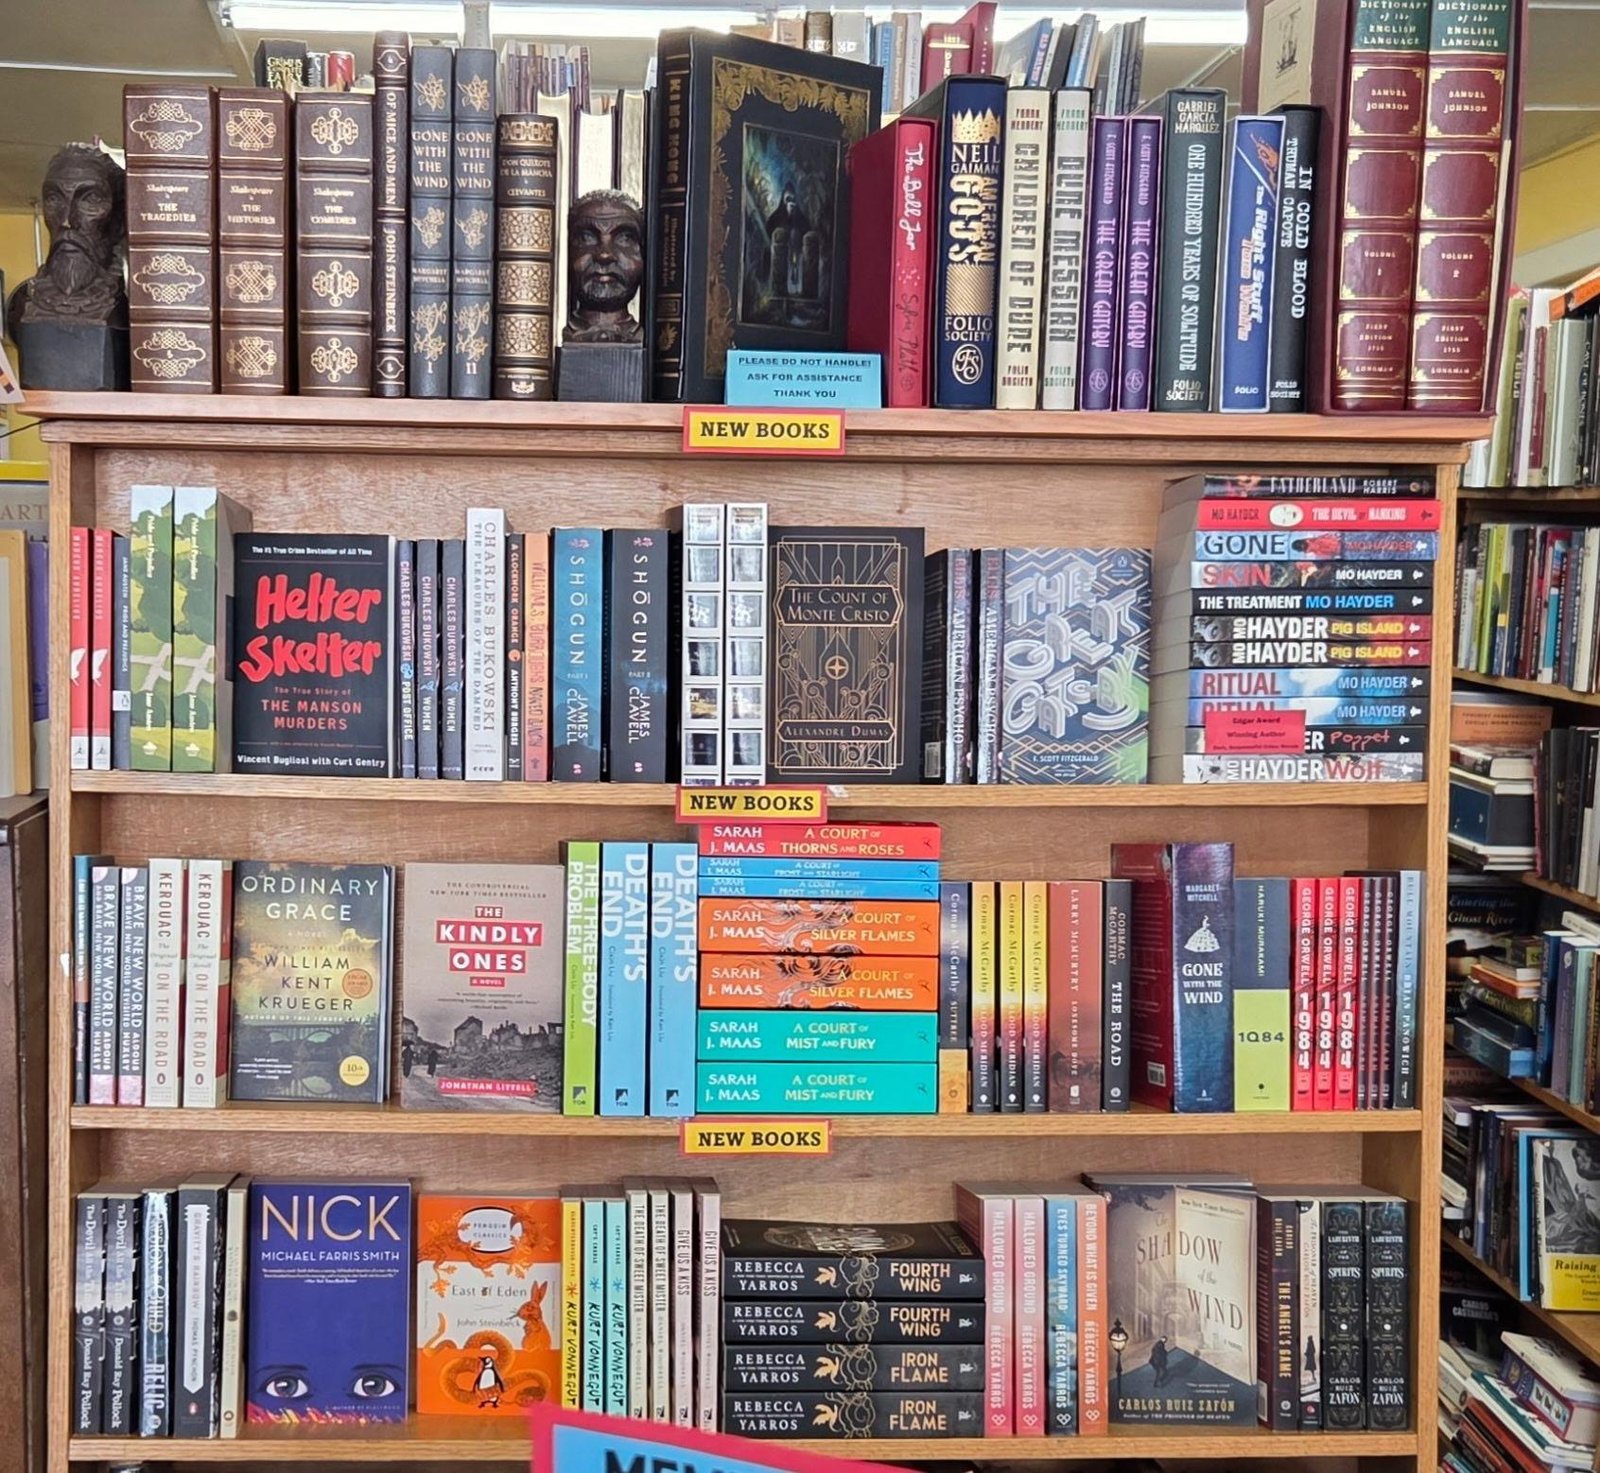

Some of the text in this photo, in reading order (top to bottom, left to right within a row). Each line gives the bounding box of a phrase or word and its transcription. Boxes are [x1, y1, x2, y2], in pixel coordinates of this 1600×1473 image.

[412, 131, 448, 144] GONE
[385, 92, 396, 206] OF MICE AND MEN
[412, 145, 447, 158] WITH
[952, 144, 1000, 163] NEIL
[418, 161, 442, 173] THE
[951, 163, 999, 174] GAIMAN
[412, 176, 448, 188] WIND
[899, 141, 924, 251] The Bell Jar
[140, 213, 196, 222] TRAGEDIES
[1292, 167, 1313, 319] IN COLD BLOOD
[1180, 144, 1205, 371] ONE HUNDRED YEARS OF SOLITUDE
[1252, 186, 1268, 323] The Right Stuff
[384, 227, 396, 332] JOHN STEINBECK
[945, 316, 992, 332] FOLIO
[944, 332, 992, 341] SOCIETY
[738, 357, 871, 368] PLEASE DO NOT HANDLE!
[747, 372, 862, 382] ASK FOR ASSISTANCE
[774, 389, 836, 398] THANK YOU
[700, 422, 830, 438] NEW BOOKS
[1204, 534, 1286, 556] GONE
[1202, 564, 1272, 586] SKIN
[256, 572, 382, 630] Helter
[790, 588, 890, 606] THE COUNT OF
[1199, 596, 1303, 609] THE TREATMENT
[1306, 596, 1394, 608] MO HAYDER
[786, 606, 890, 623] MONTE CRISTO
[483, 522, 496, 733] CHARLES BUKOWSKI
[1331, 622, 1404, 634] PIG ISLAND
[239, 632, 382, 682] Skelter
[1202, 672, 1281, 696] RITUAL
[261, 699, 362, 714] THE MANSON
[274, 716, 348, 730] MURDERS
[1232, 716, 1254, 726] Edgar
[783, 725, 889, 738] ALEXANDRE DUMAS
[1330, 730, 1390, 751] Poppet
[237, 754, 272, 764] Vincent
[311, 755, 332, 766] with
[333, 757, 354, 766] Curt
[355, 757, 386, 768] Gentry
[1326, 760, 1385, 780] Wolf
[690, 795, 814, 811] NEW BOOKS
[714, 826, 762, 838] SARAH
[804, 829, 816, 838] A
[820, 829, 869, 840] COURT
[710, 842, 766, 854] J. MAAS
[780, 842, 838, 854] THORNS
[858, 844, 904, 856] ROSES
[242, 876, 380, 896] ORDINARY
[158, 872, 172, 938] KEROUAC
[266, 902, 352, 921] GRACE
[567, 861, 583, 955] PROBLEM
[602, 870, 624, 938] END
[476, 907, 502, 918] THE
[624, 854, 648, 982] DEATH'S
[439, 924, 541, 944] KINDLY
[1256, 885, 1265, 978] HARUKI MURAKAMI
[581, 858, 599, 1027] THE THREE-BODY
[102, 884, 116, 1028] BRAVE NEW WORLD
[264, 956, 350, 970] WILLIAM
[452, 953, 524, 971] ONES
[1182, 962, 1224, 976] GONE
[282, 977, 332, 990] KENT
[1298, 888, 1312, 1069] GEORGE ORWELL 1984
[258, 996, 354, 1010] KRUEGER
[1184, 991, 1224, 1004] WIND
[1110, 982, 1122, 1066] THE ROAD
[1238, 1031, 1286, 1043] 1Q84
[440, 1082, 533, 1093] JONATHAN LITTELL
[698, 1132, 822, 1147] NEW BOOKS
[261, 1194, 401, 1242] NICK
[1136, 1230, 1223, 1266] SHADOW
[261, 1251, 400, 1262] MICHAEL FARRIS SMITH
[678, 1230, 690, 1296] GIVE US A KISS
[734, 1262, 804, 1273] REBECCA
[890, 1263, 950, 1278] FOURTH
[1328, 1267, 1360, 1279] SPIRITS
[1555, 1260, 1597, 1272] Raising
[452, 1285, 528, 1298] East of Eden
[739, 1280, 798, 1292] YARROS
[900, 1278, 942, 1293] WING
[1187, 1288, 1244, 1331] WIND
[457, 1318, 520, 1329] John Steinbeck
[1278, 1282, 1292, 1378] THE ANGEL'S GAME
[564, 1302, 578, 1406] KURT VONNEGUT
[902, 1352, 938, 1367] IRON
[890, 1368, 948, 1383] FLAME
[1118, 1398, 1162, 1411] CARLOS
[1166, 1400, 1194, 1412] RUIZ
